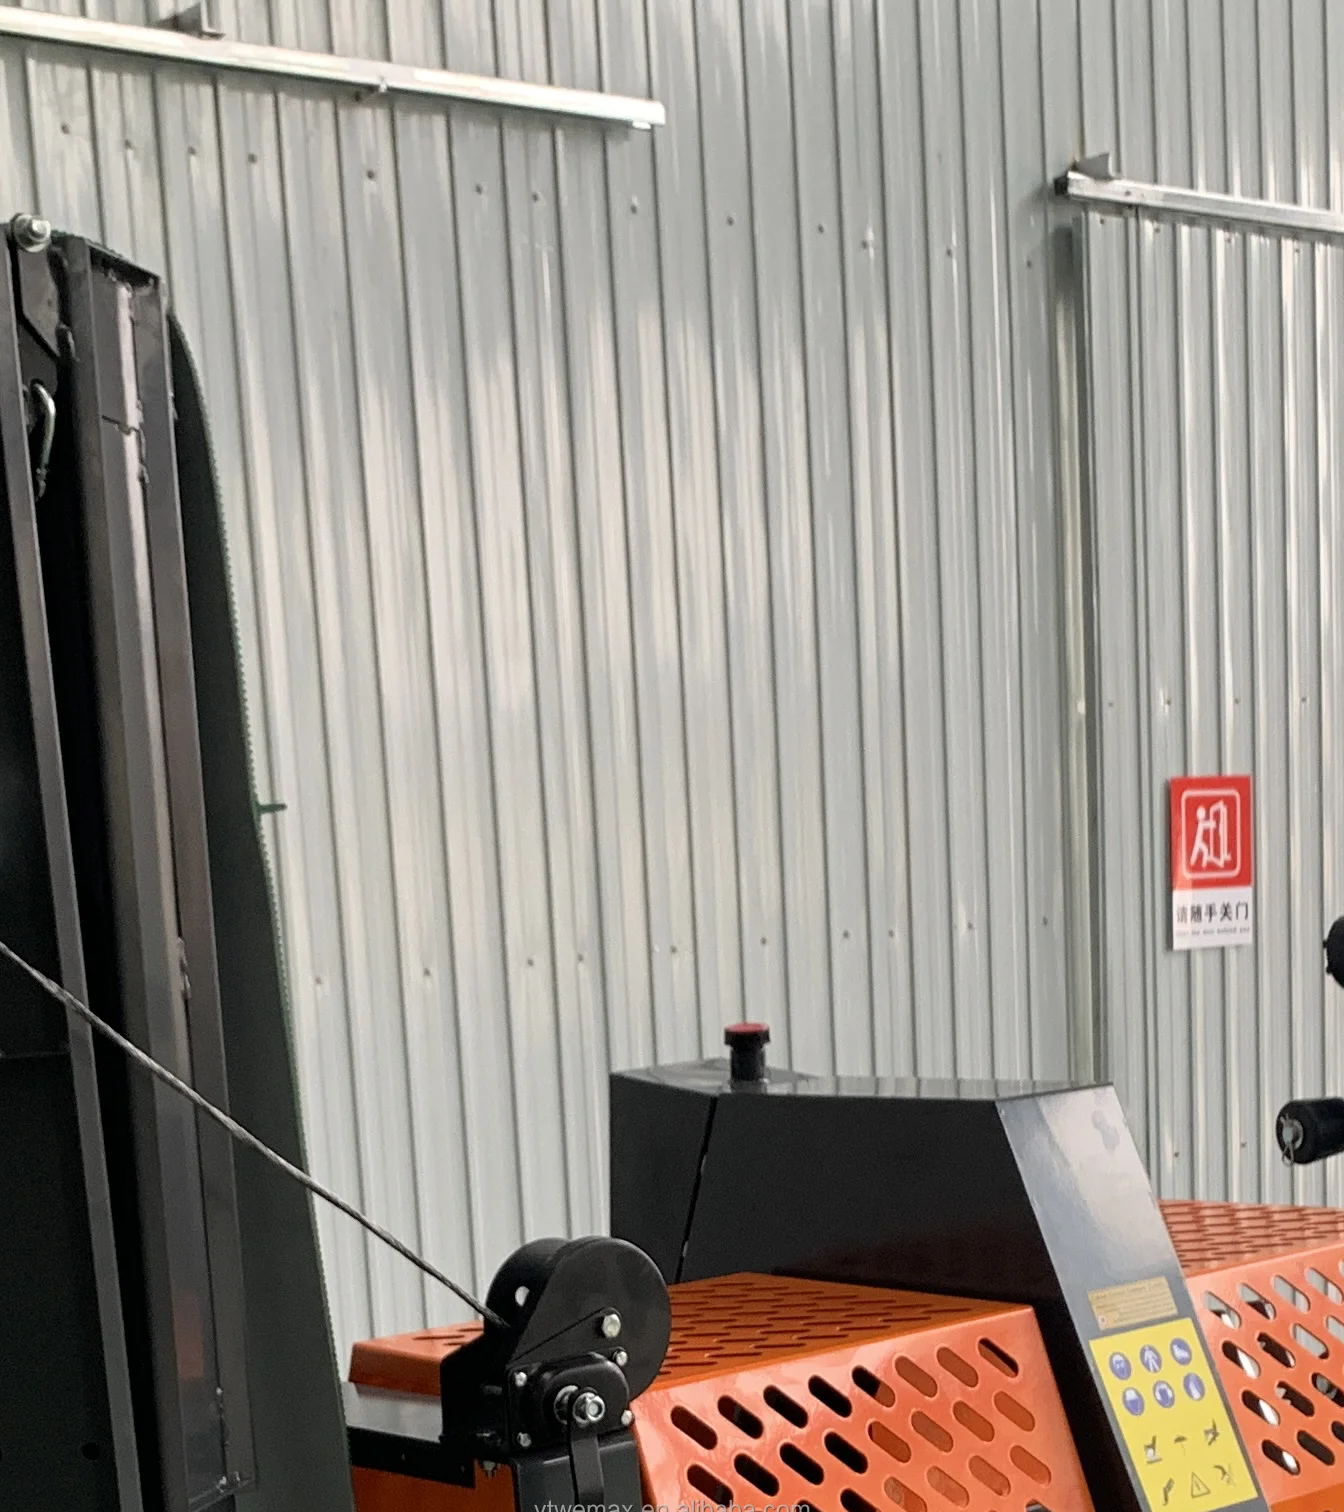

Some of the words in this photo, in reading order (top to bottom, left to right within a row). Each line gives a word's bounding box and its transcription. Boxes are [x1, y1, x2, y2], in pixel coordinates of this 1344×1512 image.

[1175, 901, 1250, 924] 请随手关门
